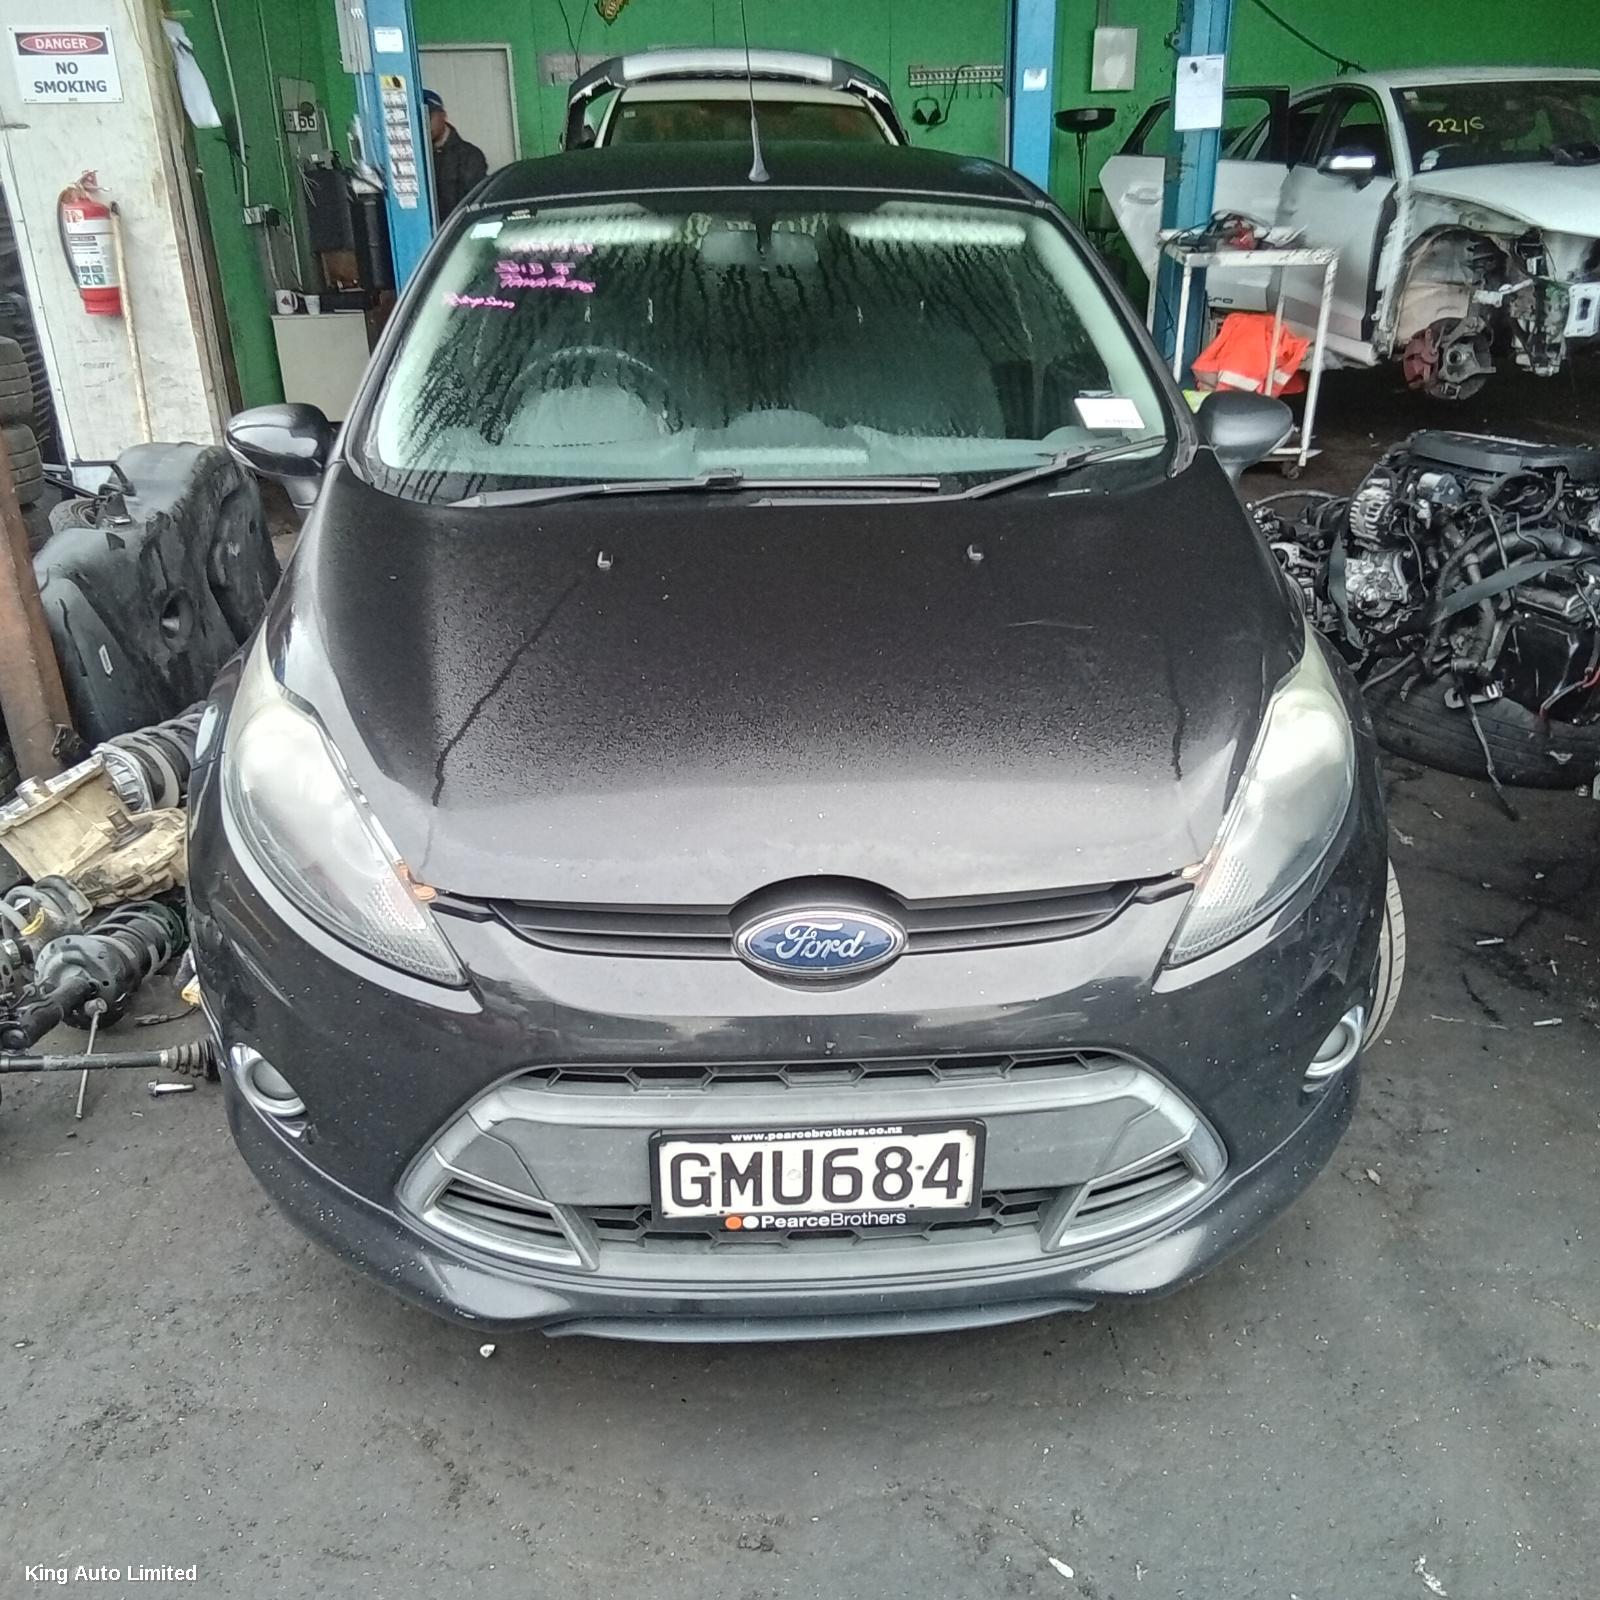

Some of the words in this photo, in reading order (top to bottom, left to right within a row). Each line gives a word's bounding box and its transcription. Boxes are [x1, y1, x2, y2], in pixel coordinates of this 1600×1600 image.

[35, 38, 89, 49] DANGER
[55, 61, 79, 75] NO
[34, 80, 107, 93] SMOKING
[1428, 116, 1485, 135] 2216
[776, 922, 866, 960] Ford
[731, 1126, 903, 1142] www.pearcebrothers.co.nz
[670, 1142, 963, 1208] GMU684
